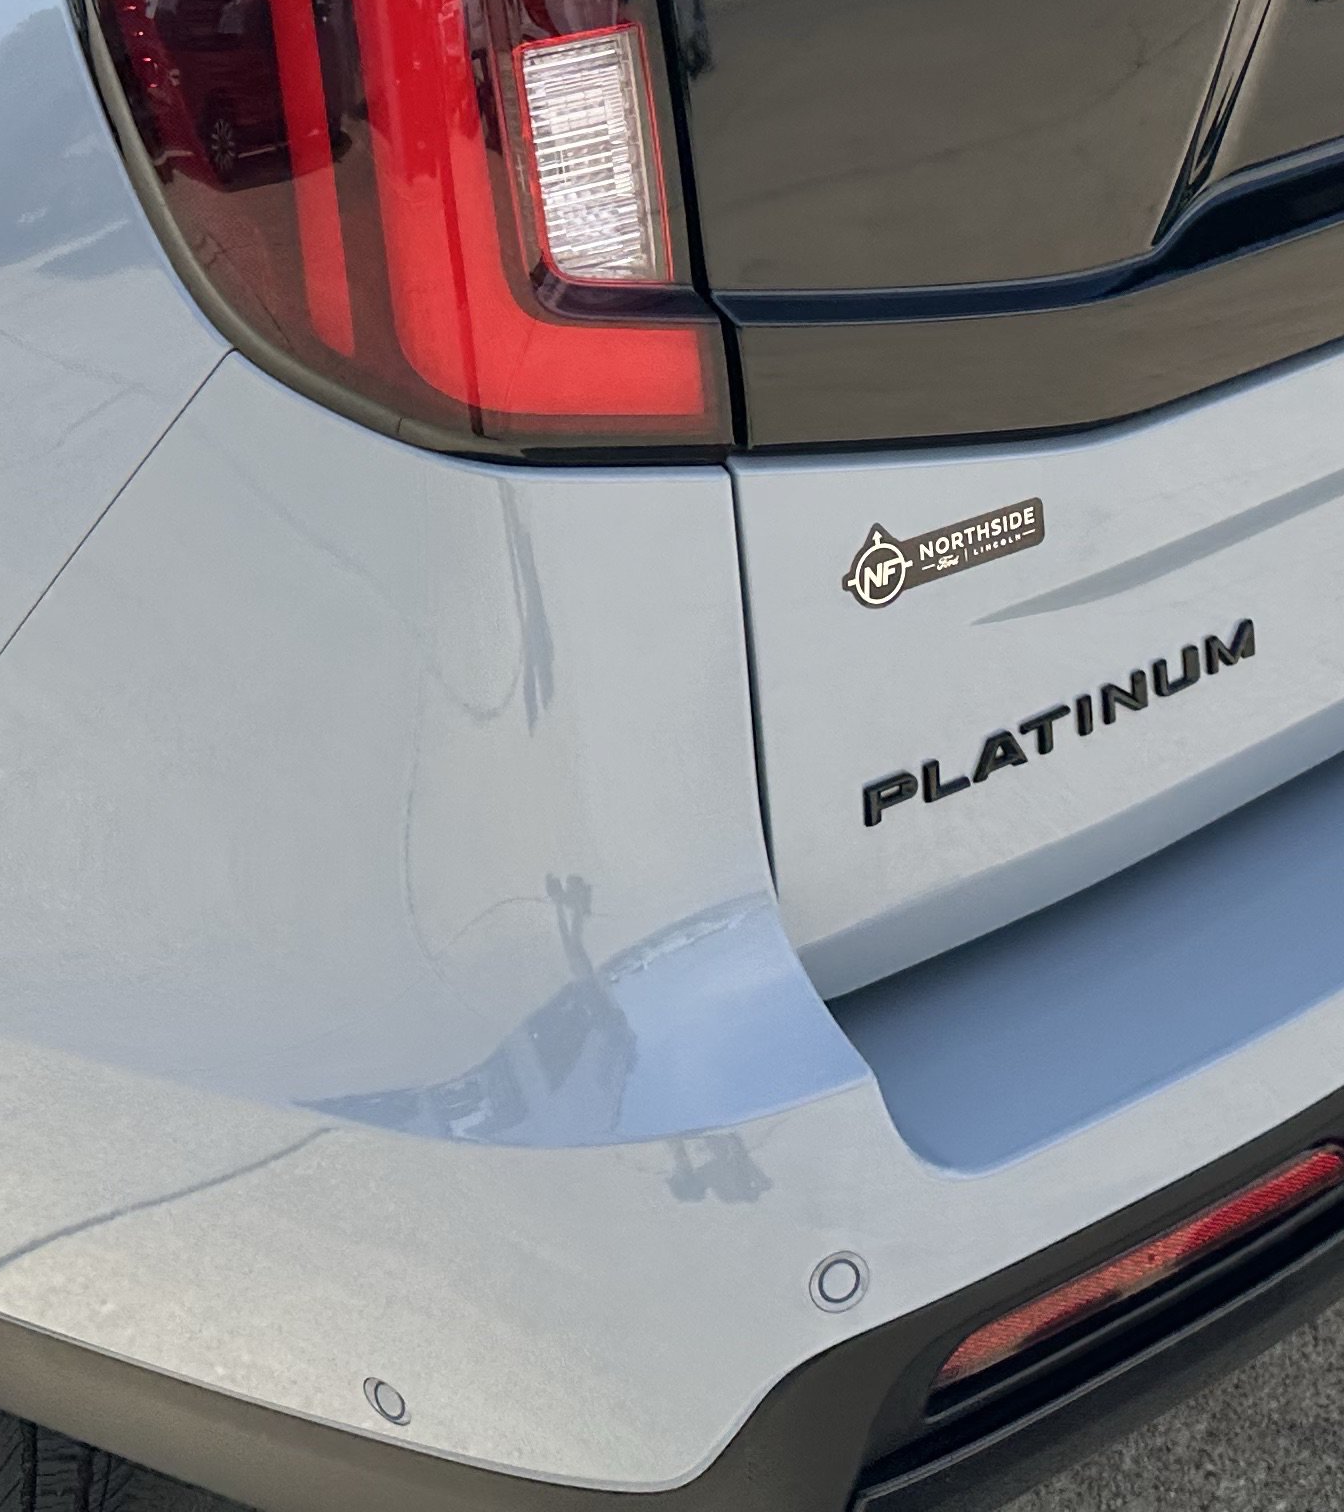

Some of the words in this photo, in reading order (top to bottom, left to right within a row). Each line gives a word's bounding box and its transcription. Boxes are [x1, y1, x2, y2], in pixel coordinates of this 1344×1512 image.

[919, 506, 1036, 561] NORTHSIDE
[973, 533, 1022, 556] LINCOLN
[863, 556, 904, 598] NF
[862, 617, 1257, 828] PLATINUM
